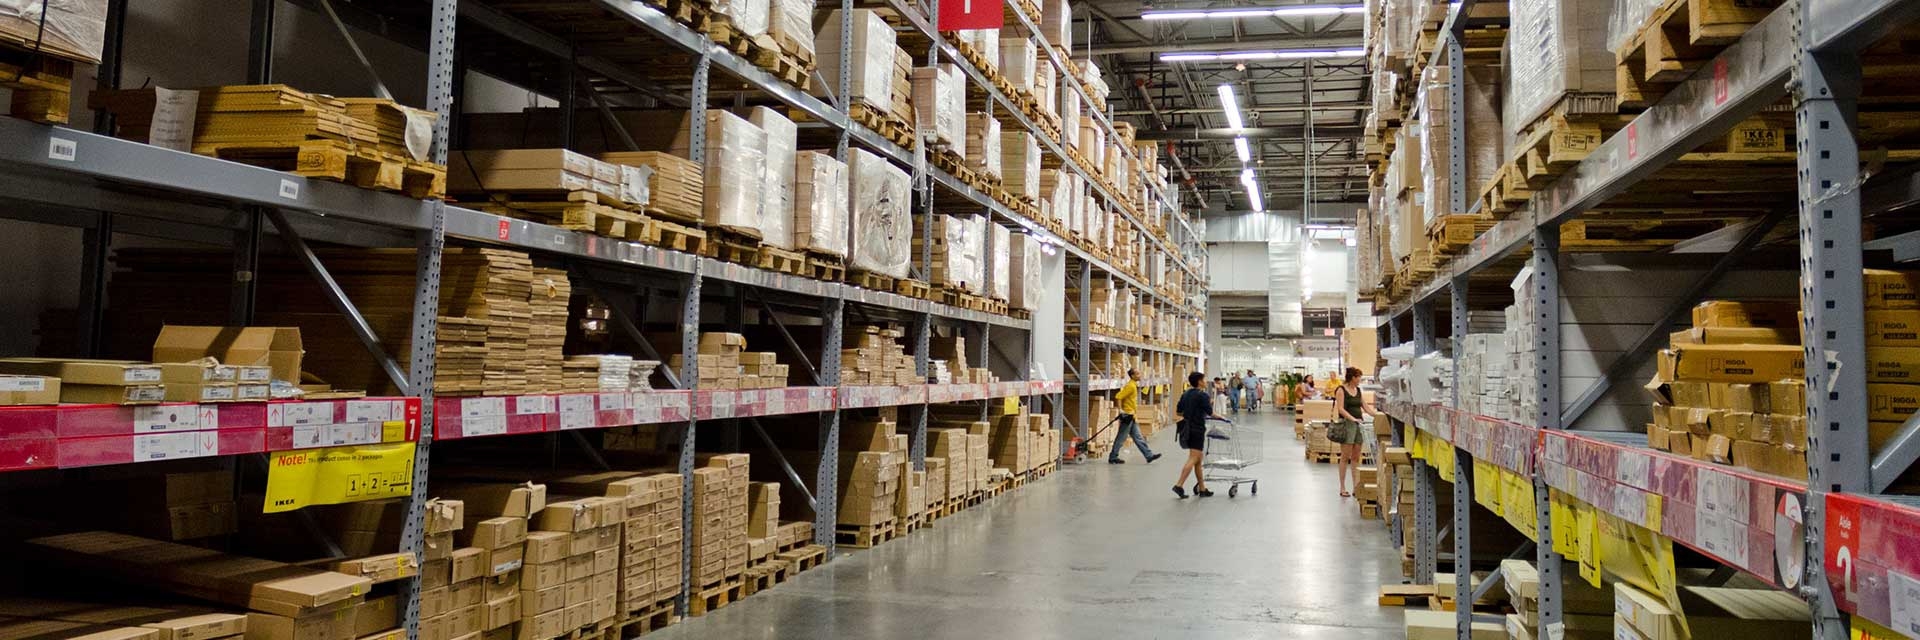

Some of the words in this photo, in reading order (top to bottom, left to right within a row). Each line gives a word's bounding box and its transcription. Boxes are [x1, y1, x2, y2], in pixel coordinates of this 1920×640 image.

[1743, 130, 1774, 139] IKEA
[1878, 361, 1902, 369] RIGGA
[1893, 396, 1917, 404] RIGGA
[409, 418, 416, 441] 1
[278, 454, 306, 467] Note!
[351, 479, 356, 491] 1
[371, 478, 378, 490] 2
[275, 499, 295, 507] IKEA
[1836, 546, 1858, 603] 2
